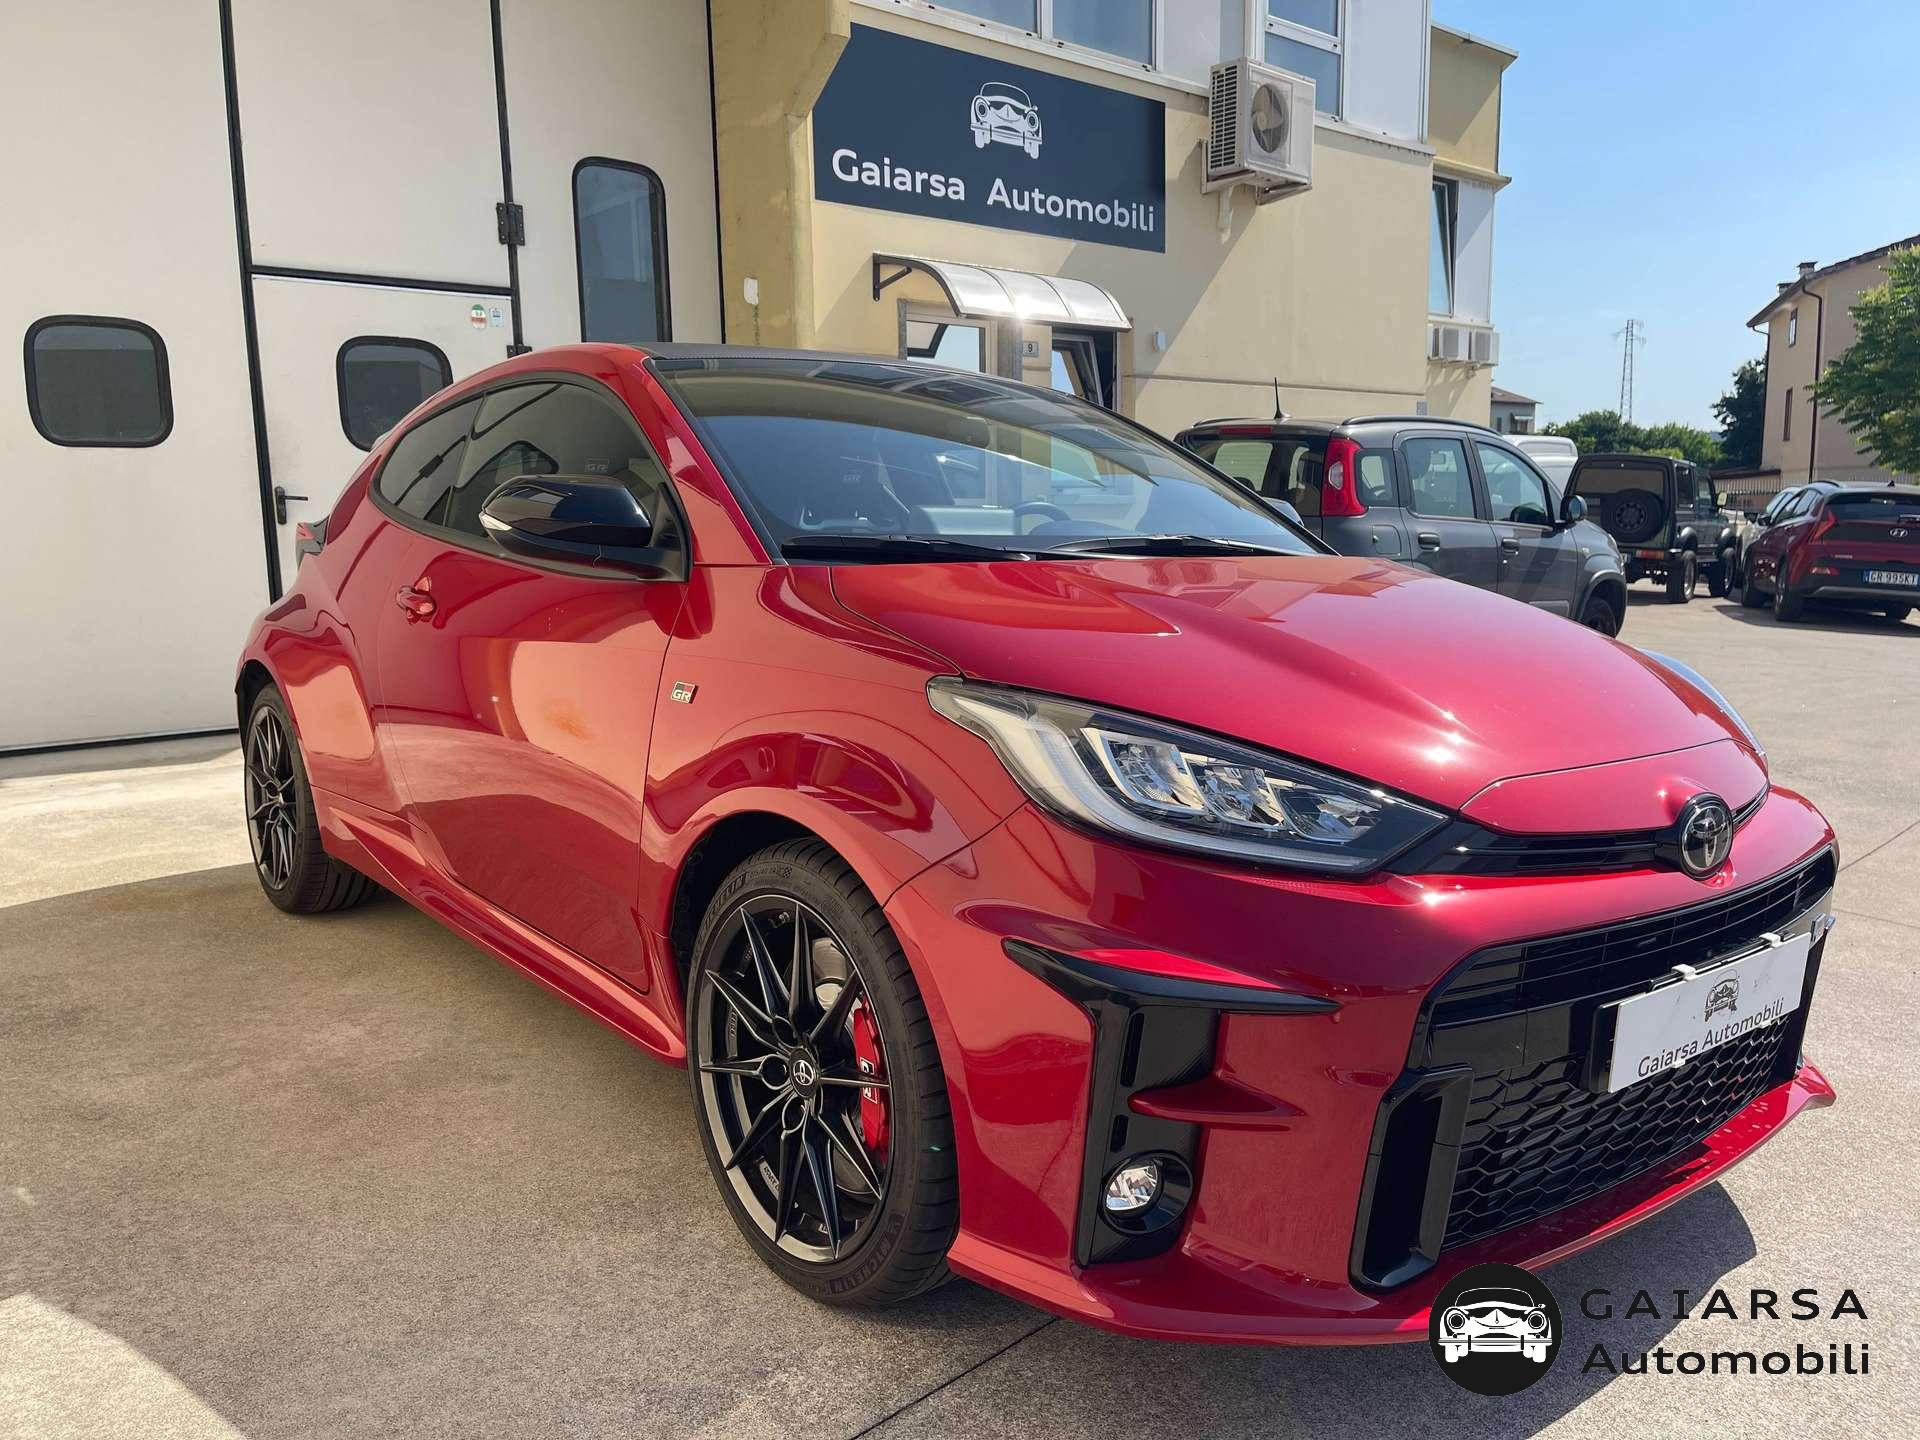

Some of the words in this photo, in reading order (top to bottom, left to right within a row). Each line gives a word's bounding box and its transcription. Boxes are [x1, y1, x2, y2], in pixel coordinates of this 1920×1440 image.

[832, 148, 965, 201] Gaiarsa
[986, 178, 1155, 232] Automobili
[1028, 343, 1033, 353] 9
[672, 689, 691, 701] GR
[1637, 1040, 1698, 1078] Gaiarsa
[1702, 997, 1784, 1049] Automobili
